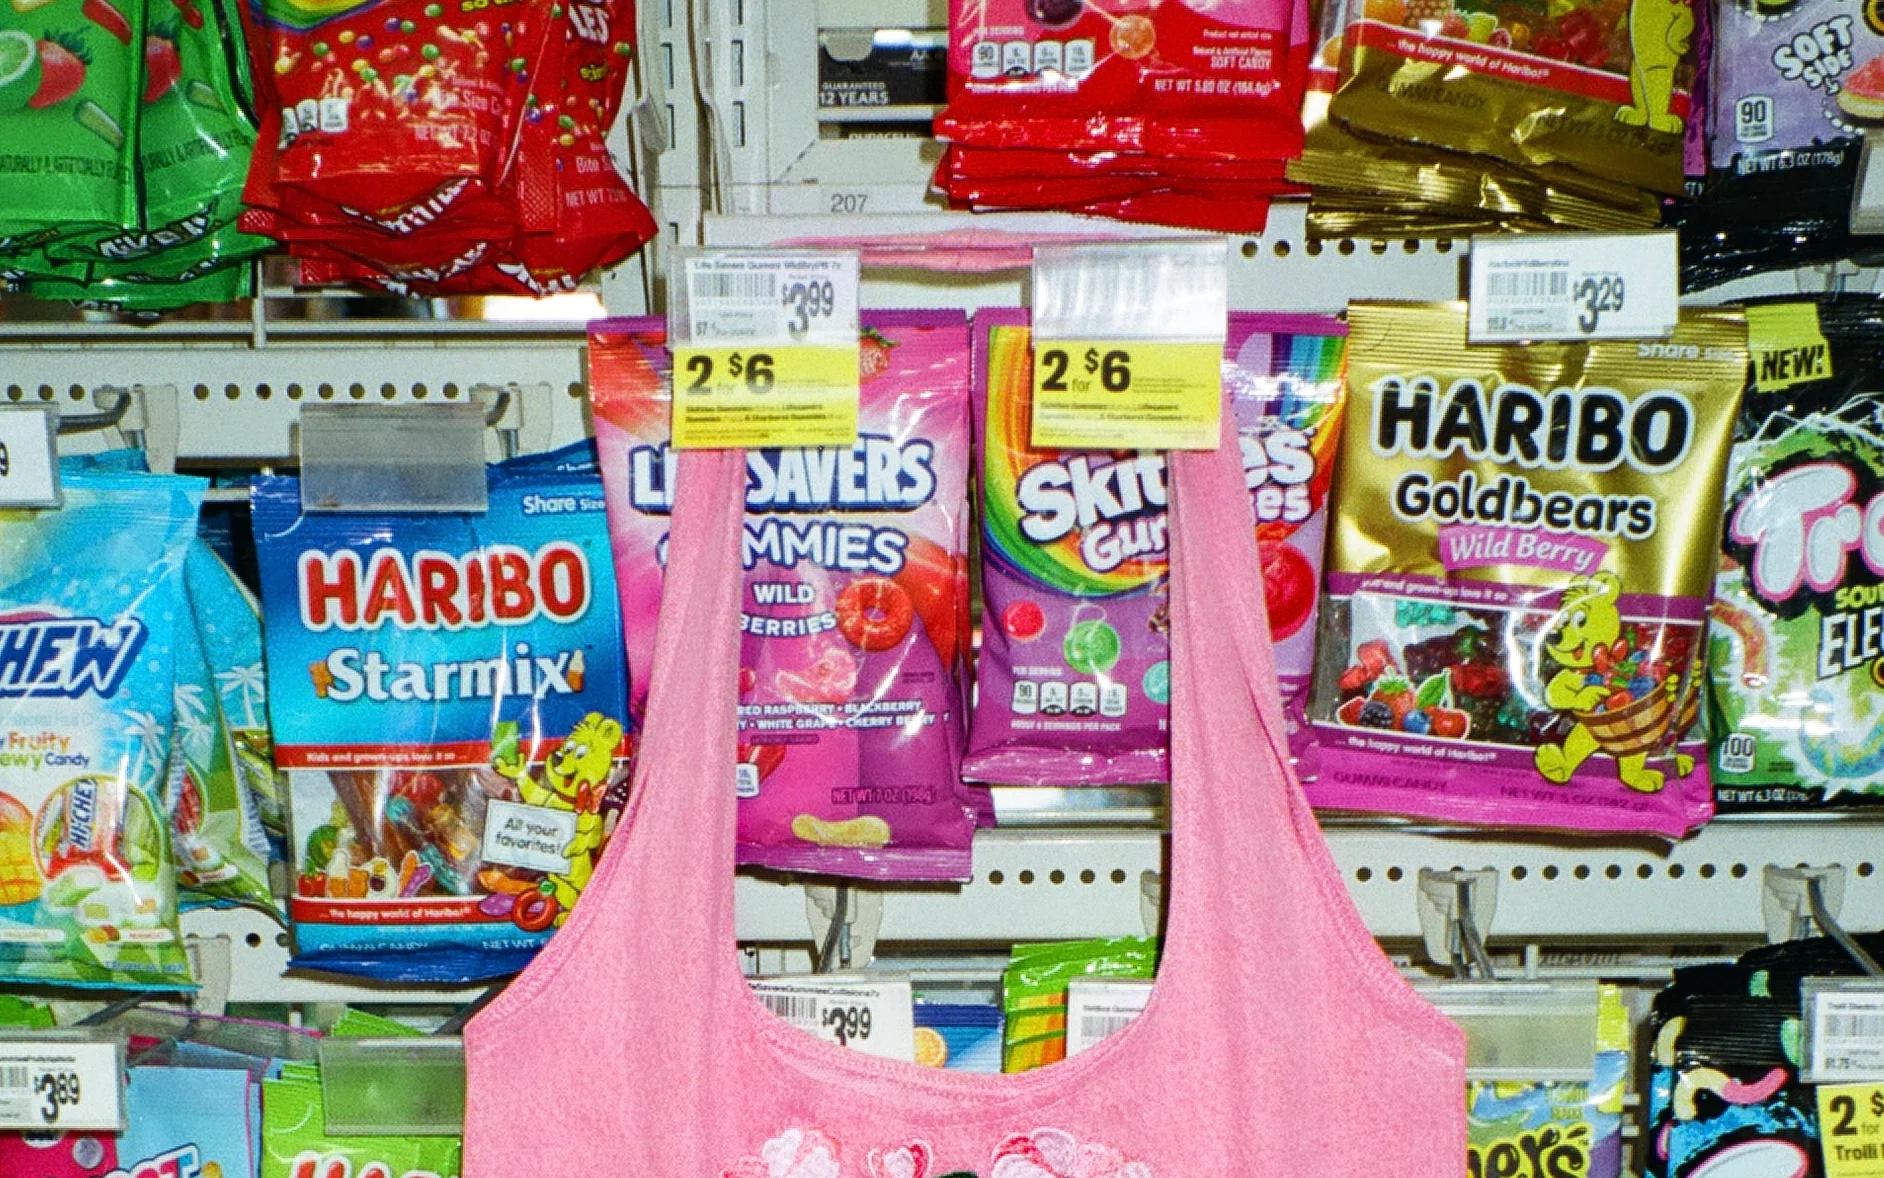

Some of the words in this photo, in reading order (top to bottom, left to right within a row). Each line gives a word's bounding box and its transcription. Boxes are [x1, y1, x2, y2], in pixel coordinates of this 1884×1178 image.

[1397, 37, 1415, 55] the
[1418, 42, 1452, 62] happy
[1455, 50, 1487, 68] world
[1488, 57, 1501, 70] of
[1774, 15, 1852, 80] SOFT
[1211, 56, 1235, 69] SOFT
[1238, 57, 1272, 70] CANDY
[1802, 48, 1852, 89] SIDE
[1155, 79, 1174, 91] NET
[1175, 80, 1193, 92] WT
[1217, 82, 1231, 94] OZ
[820, 90, 835, 105] 12
[839, 90, 889, 105] YEARS
[1741, 100, 1766, 124] 90
[1738, 156, 1759, 174] NET
[1760, 155, 1776, 171] WT
[565, 192, 584, 208] NET
[586, 190, 606, 206] WT
[831, 193, 868, 213] 207
[1637, 341, 1700, 360] Share
[1041, 349, 1069, 392] 2
[1072, 378, 1091, 393] for
[1084, 347, 1131, 393] $6
[1761, 344, 1825, 382] NEW!
[686, 355, 713, 396] 2
[729, 352, 775, 395] $6
[1375, 378, 1692, 470] HARIBO
[744, 434, 936, 505] SAVERS
[523, 495, 576, 513] Share
[1394, 471, 1654, 536] Goldbears
[1450, 533, 1510, 563] Wild
[1518, 536, 1596, 571] Berry
[304, 546, 588, 628] HARIBO
[753, 583, 817, 604] WILD
[740, 611, 838, 637] BERRIES
[326, 642, 573, 702] Starmix
[764, 702, 835, 715] RASPBERRY
[844, 700, 922, 714] BLACKBERRY
[756, 718, 793, 730] WHITE
[845, 715, 893, 728] CHERRY
[1100, 722, 1122, 732] PACK
[8, 731, 71, 756] Fruity
[1348, 735, 1366, 748] the
[1368, 738, 1401, 754] happy
[1402, 743, 1431, 755] world
[1434, 745, 1446, 756] of
[1722, 735, 1754, 757] 100
[45, 752, 91, 769] Candy
[306, 751, 330, 763] Kids
[332, 752, 351, 763] and
[1333, 771, 1387, 788] GUMMI
[1390, 775, 1449, 791] CANDY
[832, 787, 851, 804] NET
[856, 787, 873, 804] WT
[1501, 785, 1525, 800] NET
[1527, 787, 1546, 801] WT
[1716, 788, 1736, 802] NET
[1737, 788, 1754, 802] WT
[1773, 787, 1786, 802] OZ
[504, 817, 524, 831] All
[525, 822, 558, 838] your
[496, 832, 563, 855] favorites!
[347, 907, 380, 921] happy
[380, 907, 411, 919] world
[412, 907, 424, 918] of
[1829, 1095, 1858, 1137] 2
[1862, 1123, 1880, 1136] for
[1835, 1144, 1880, 1162] Trolli
